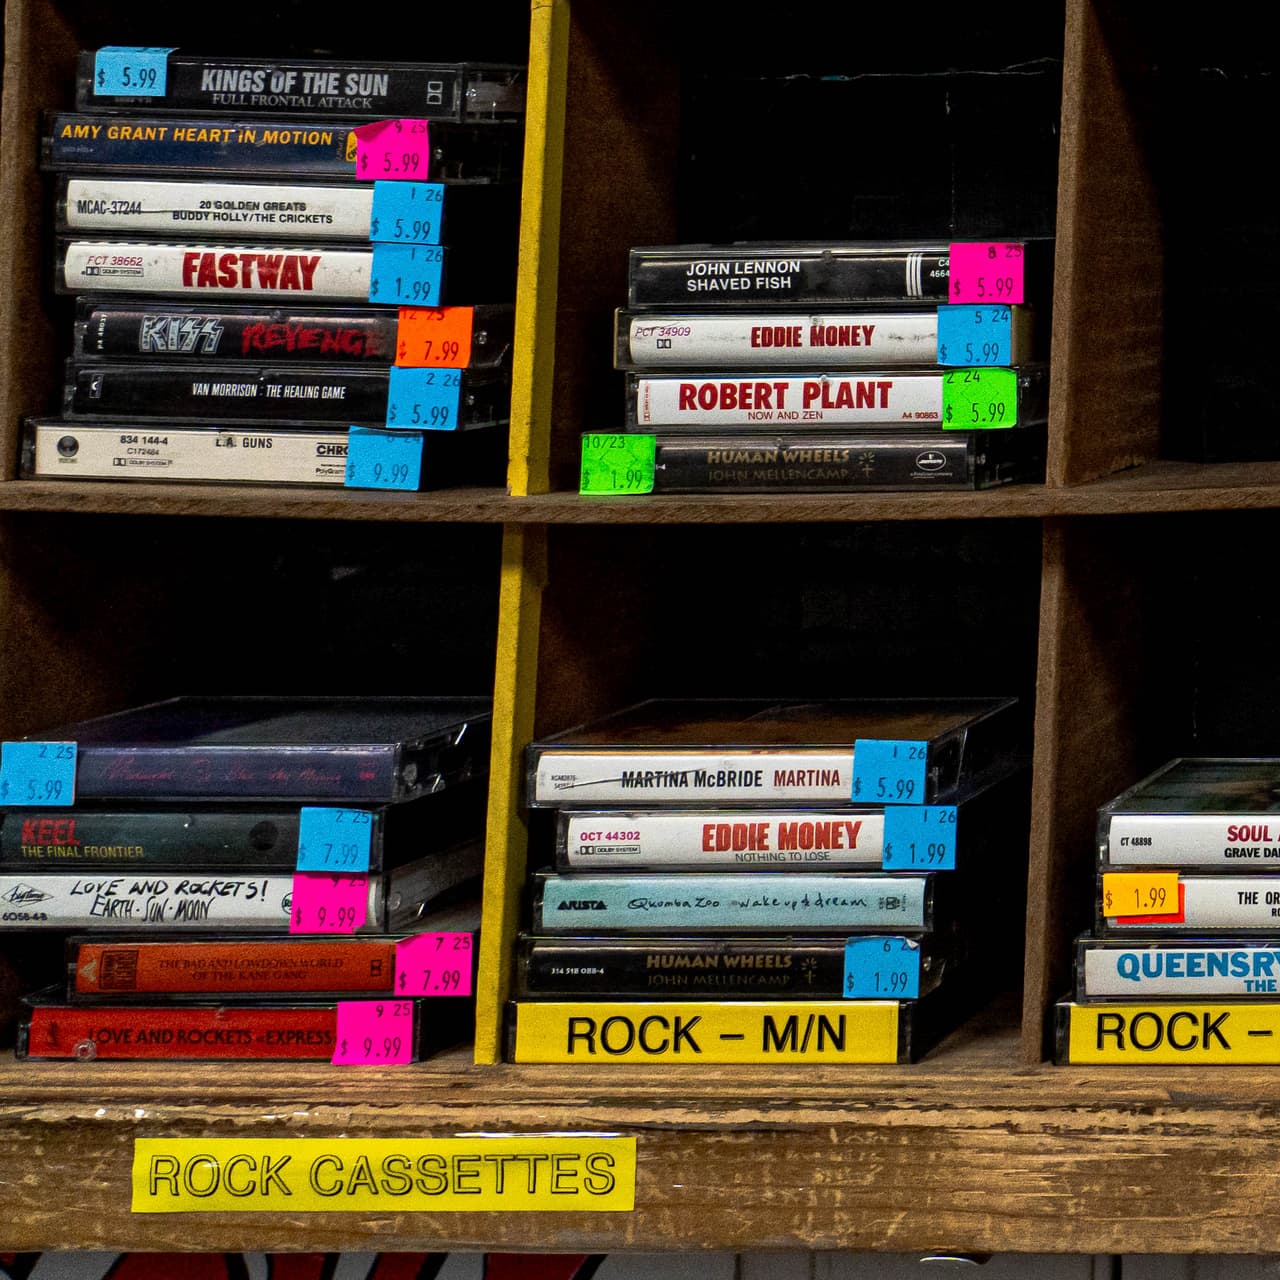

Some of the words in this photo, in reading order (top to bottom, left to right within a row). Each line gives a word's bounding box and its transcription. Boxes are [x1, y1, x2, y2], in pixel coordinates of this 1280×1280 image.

[202, 68, 262, 93] KINGS
[270, 71, 297, 94] OF
[302, 71, 340, 95] THE
[345, 73, 388, 96] SUN
[61, 125, 101, 138] AMY
[107, 126, 168, 141] GRANT
[173, 128, 231, 143] HEART
[238, 129, 257, 144] IN
[263, 130, 332, 145] MOTION
[182, 252, 322, 291] FASTWAY
[687, 261, 731, 276] JOHN
[734, 260, 800, 275] LENNON
[679, 382, 789, 411] ROBERT
[803, 381, 893, 409] PLANT
[702, 824, 770, 852] EDDIE
[778, 821, 862, 850] MONEY
[1227, 825, 1273, 842] SOUL
[70, 880, 124, 896] LOVE
[129, 881, 168, 896] AND
[567, 1016, 701, 1054] ROCK
[762, 1014, 847, 1053] M/N
[1096, 1011, 1232, 1051] ROCK
[149, 1154, 292, 1196] ROCK
[309, 1152, 615, 1196] CASSETTES
